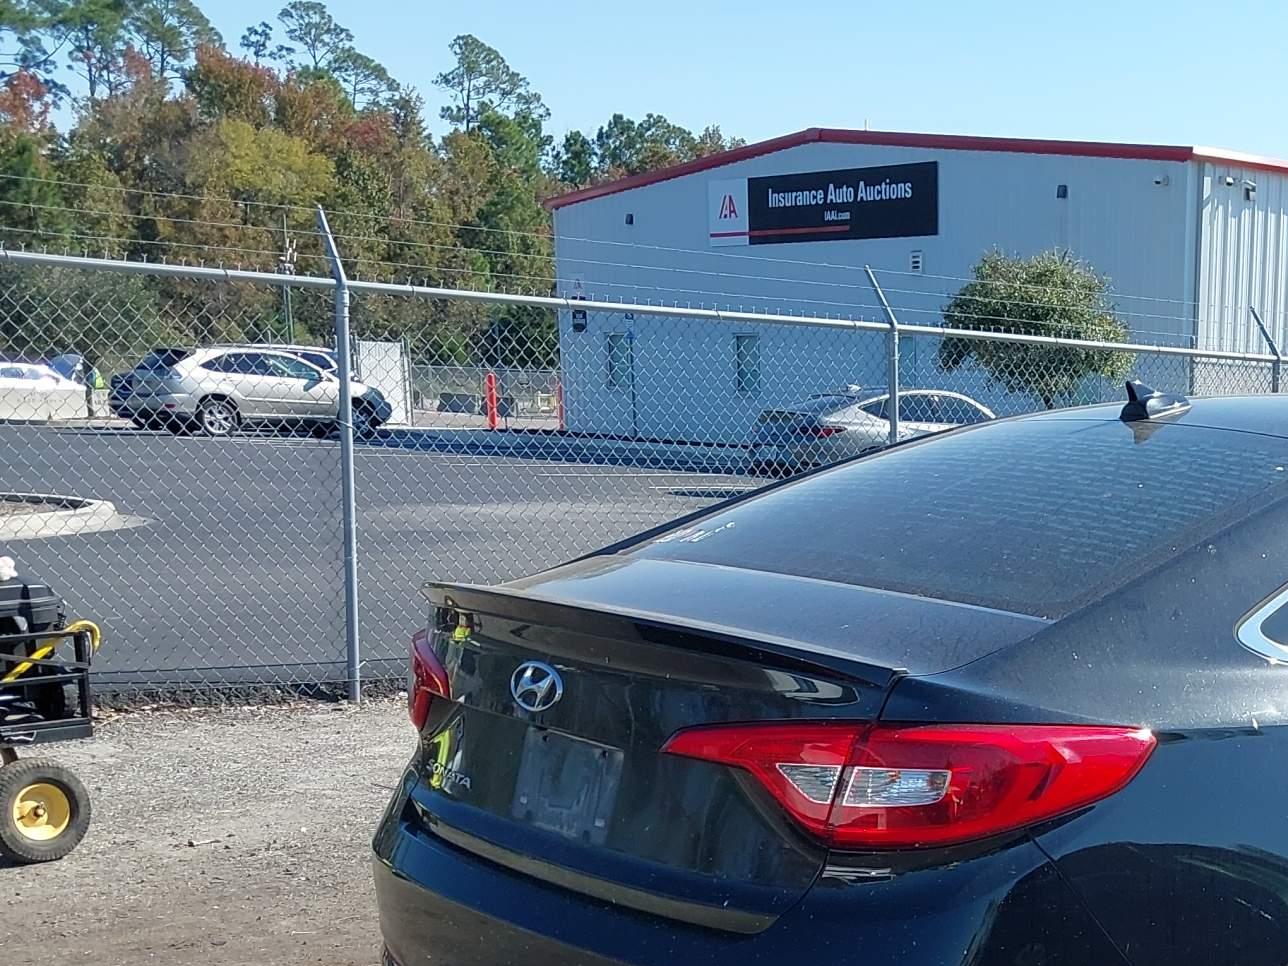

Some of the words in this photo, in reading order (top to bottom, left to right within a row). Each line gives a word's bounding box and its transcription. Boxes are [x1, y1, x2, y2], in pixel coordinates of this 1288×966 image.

[768, 188, 825, 208] Insurance
[826, 183, 855, 204] Auto
[857, 178, 913, 202] Auctions
